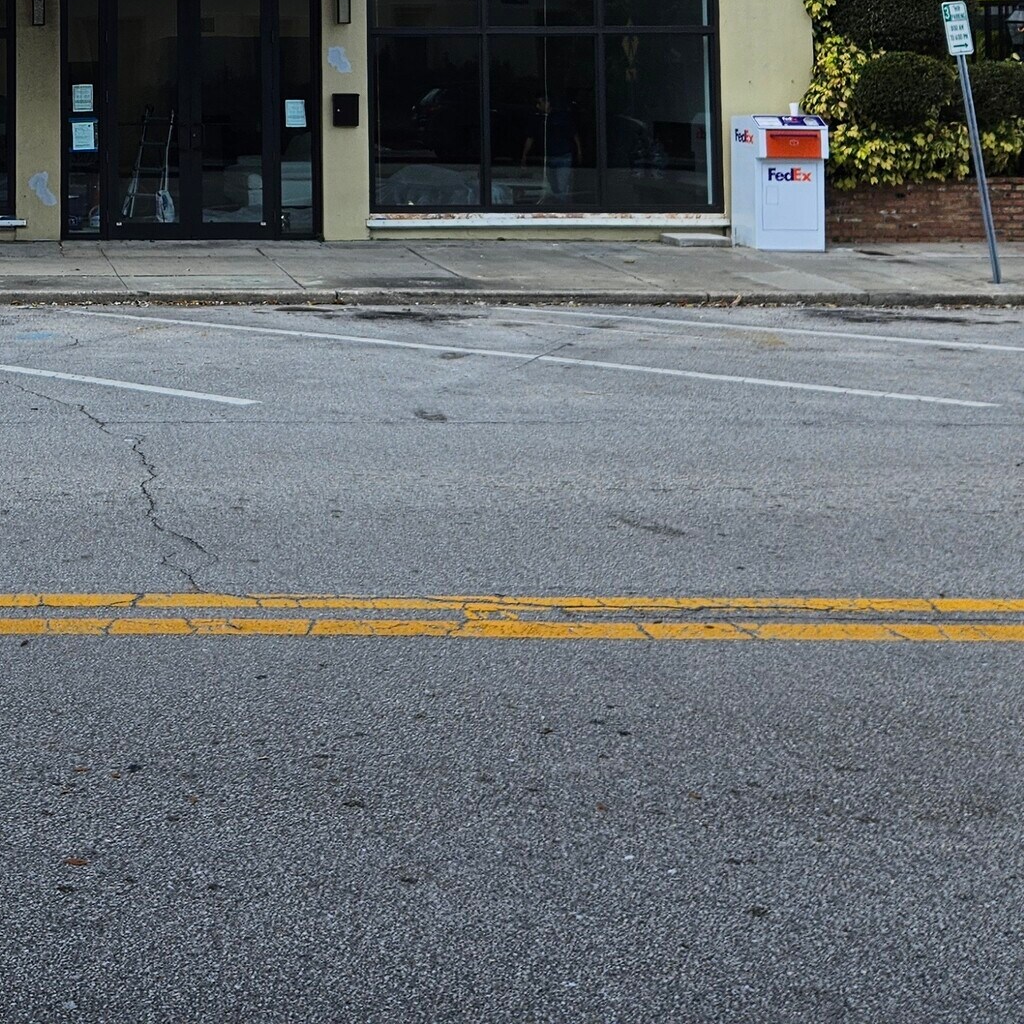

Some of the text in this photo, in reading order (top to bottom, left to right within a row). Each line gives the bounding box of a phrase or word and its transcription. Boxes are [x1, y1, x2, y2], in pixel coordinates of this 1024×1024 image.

[943, 6, 950, 19] 3
[735, 129, 754, 144] FedEx
[768, 167, 812, 182] FedEx
